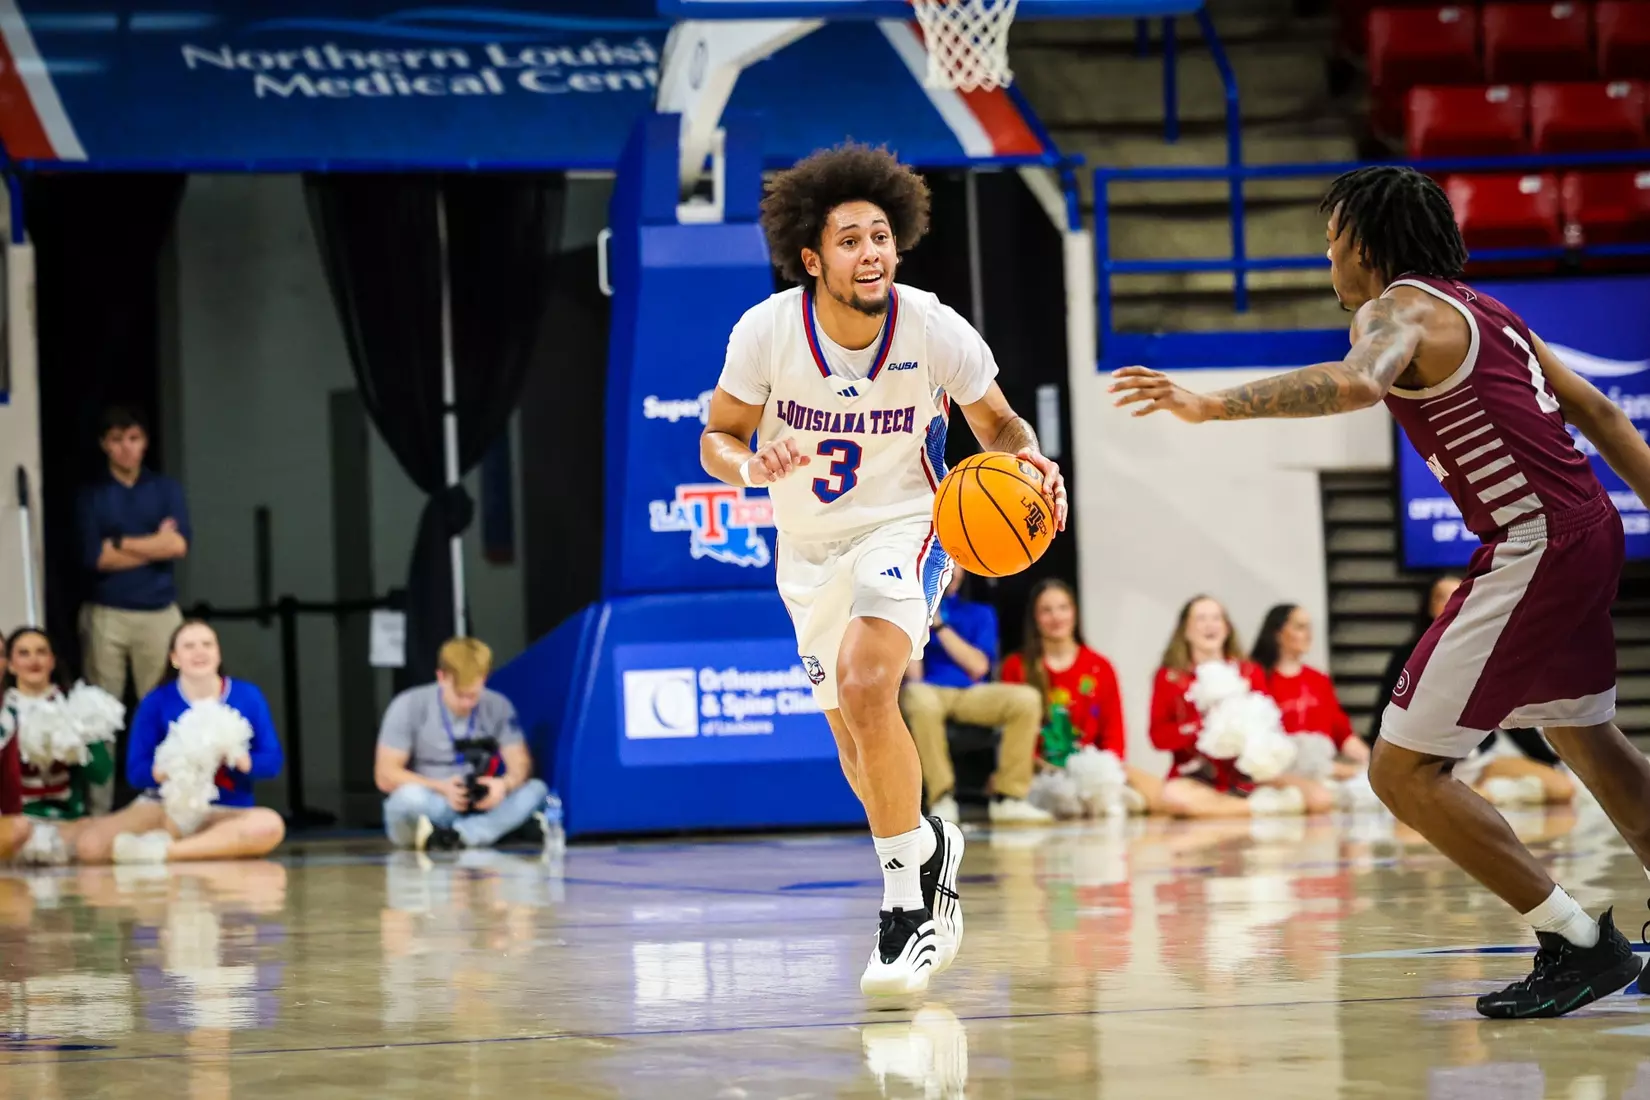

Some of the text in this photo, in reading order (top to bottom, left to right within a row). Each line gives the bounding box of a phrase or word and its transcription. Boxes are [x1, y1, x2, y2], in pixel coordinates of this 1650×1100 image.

[181, 41, 471, 70] Northern
[253, 66, 505, 98] Medical
[777, 400, 916, 434] LOUISIANA TECH
[812, 438, 863, 503] 3
[700, 692, 720, 718] &
[721, 691, 777, 721] Spine
